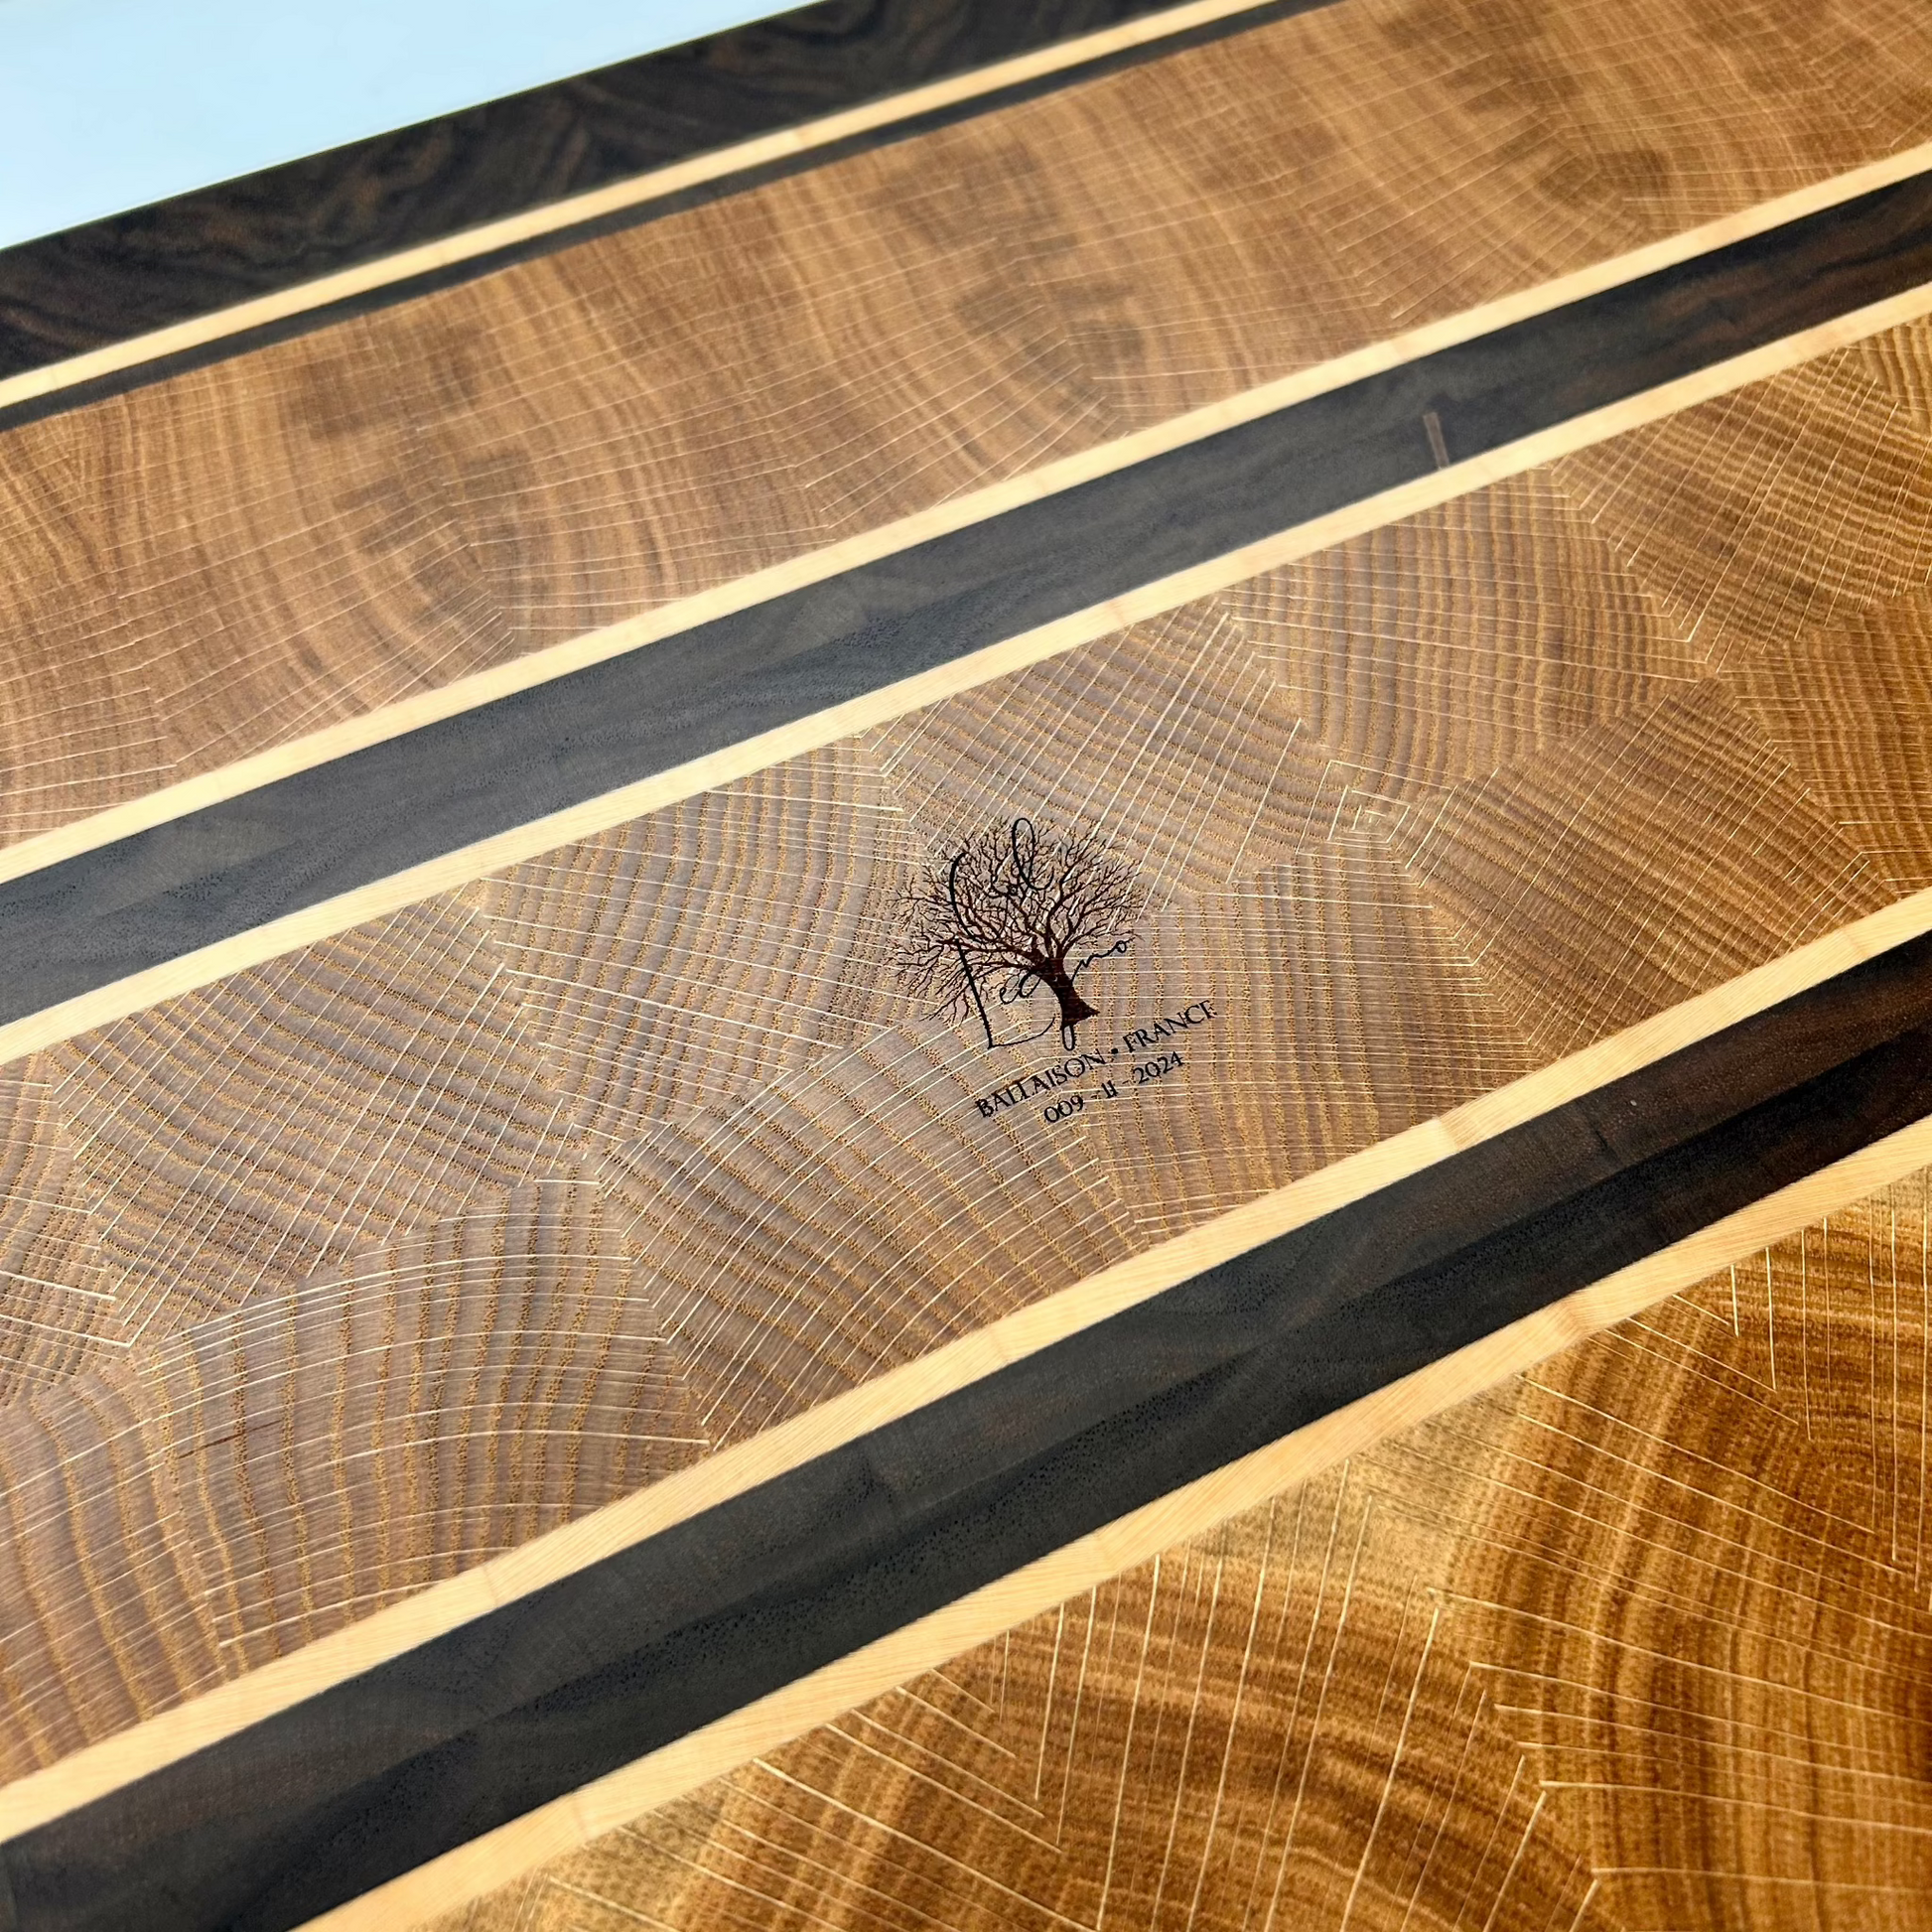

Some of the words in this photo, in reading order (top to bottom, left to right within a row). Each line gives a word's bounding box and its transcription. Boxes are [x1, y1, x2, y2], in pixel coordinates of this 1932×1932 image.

[1123, 1000, 1217, 1053] FRANCE
[1043, 1095, 1085, 1123] 009
[1133, 1050, 1184, 1084] 2024
